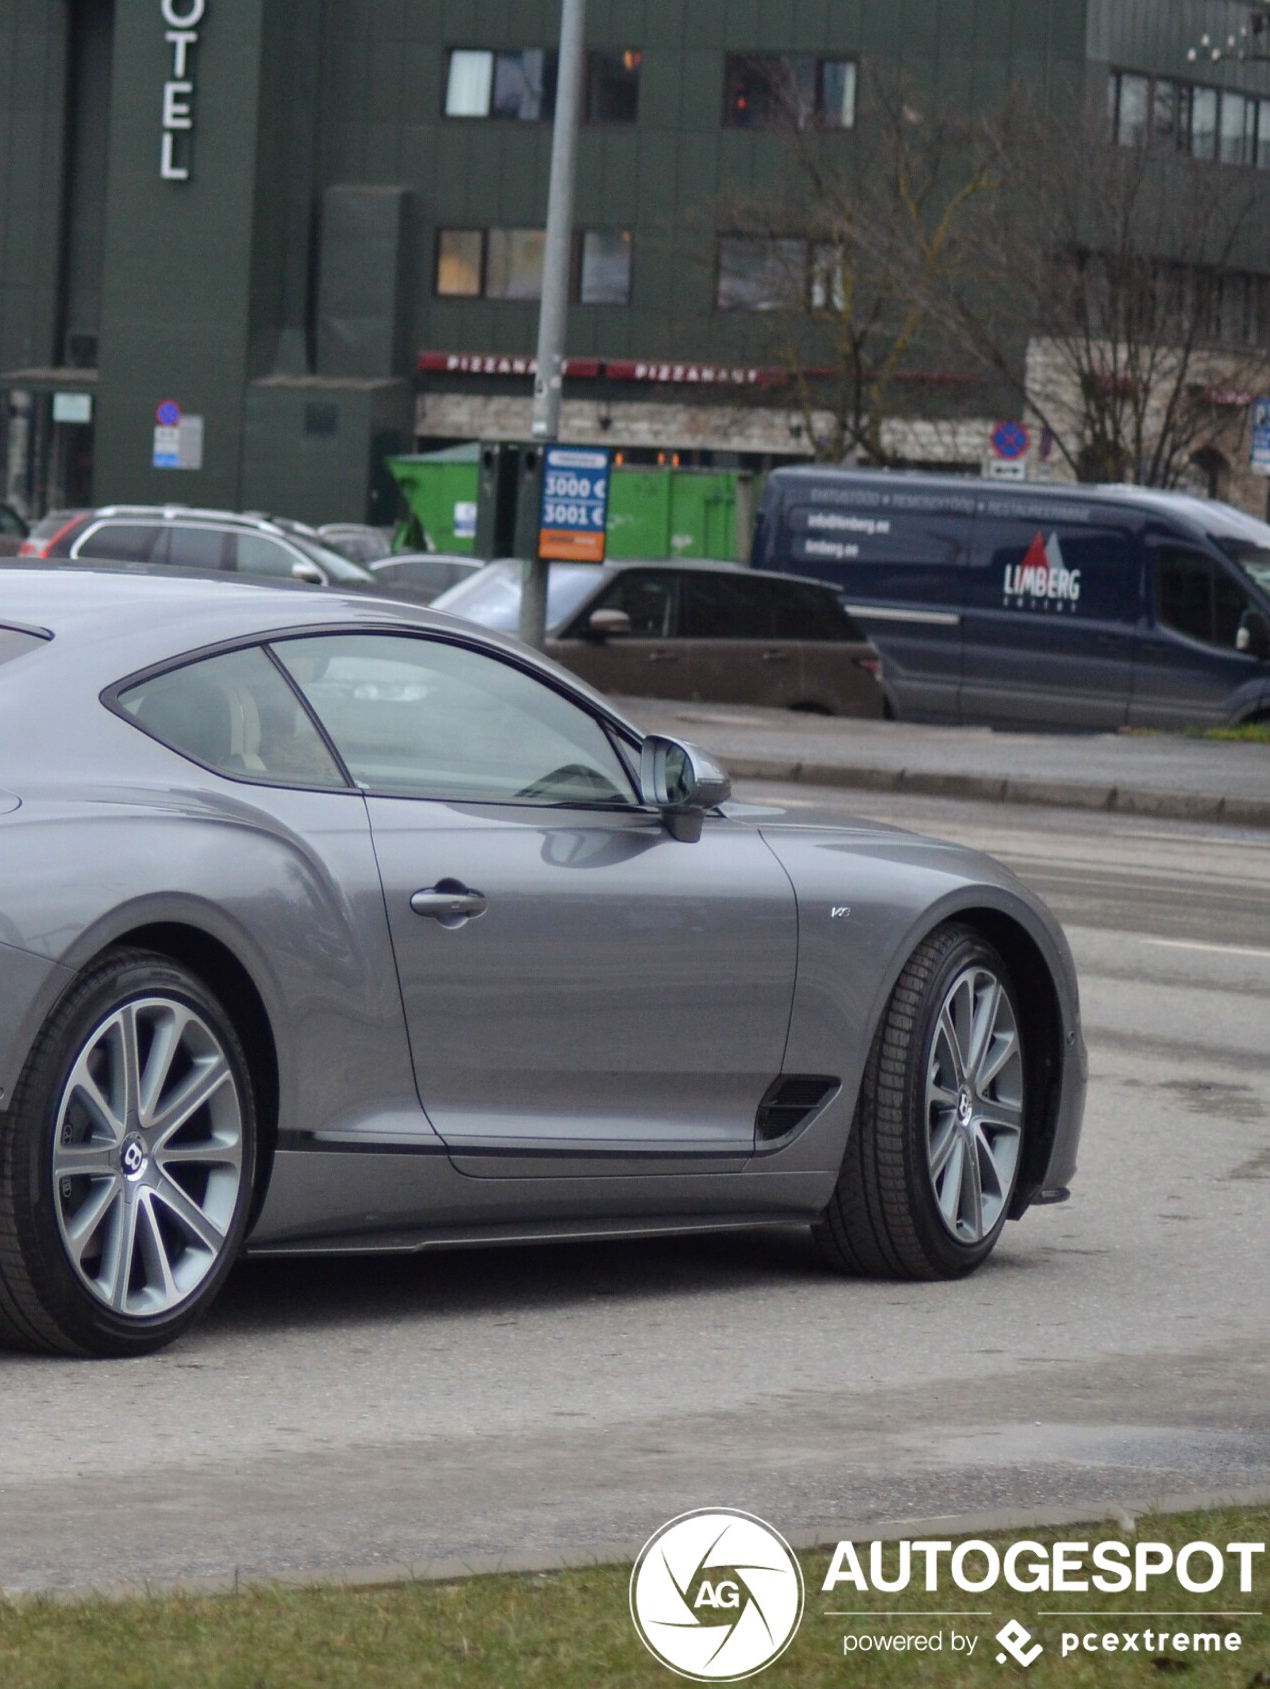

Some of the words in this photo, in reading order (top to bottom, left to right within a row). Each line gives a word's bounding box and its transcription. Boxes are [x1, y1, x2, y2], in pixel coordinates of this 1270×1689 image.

[446, 355, 568, 374] PIZZANAT
[545, 477, 591, 497] 3000
[543, 504, 589, 525] 3001
[1003, 563, 1081, 600] LIMBERG
